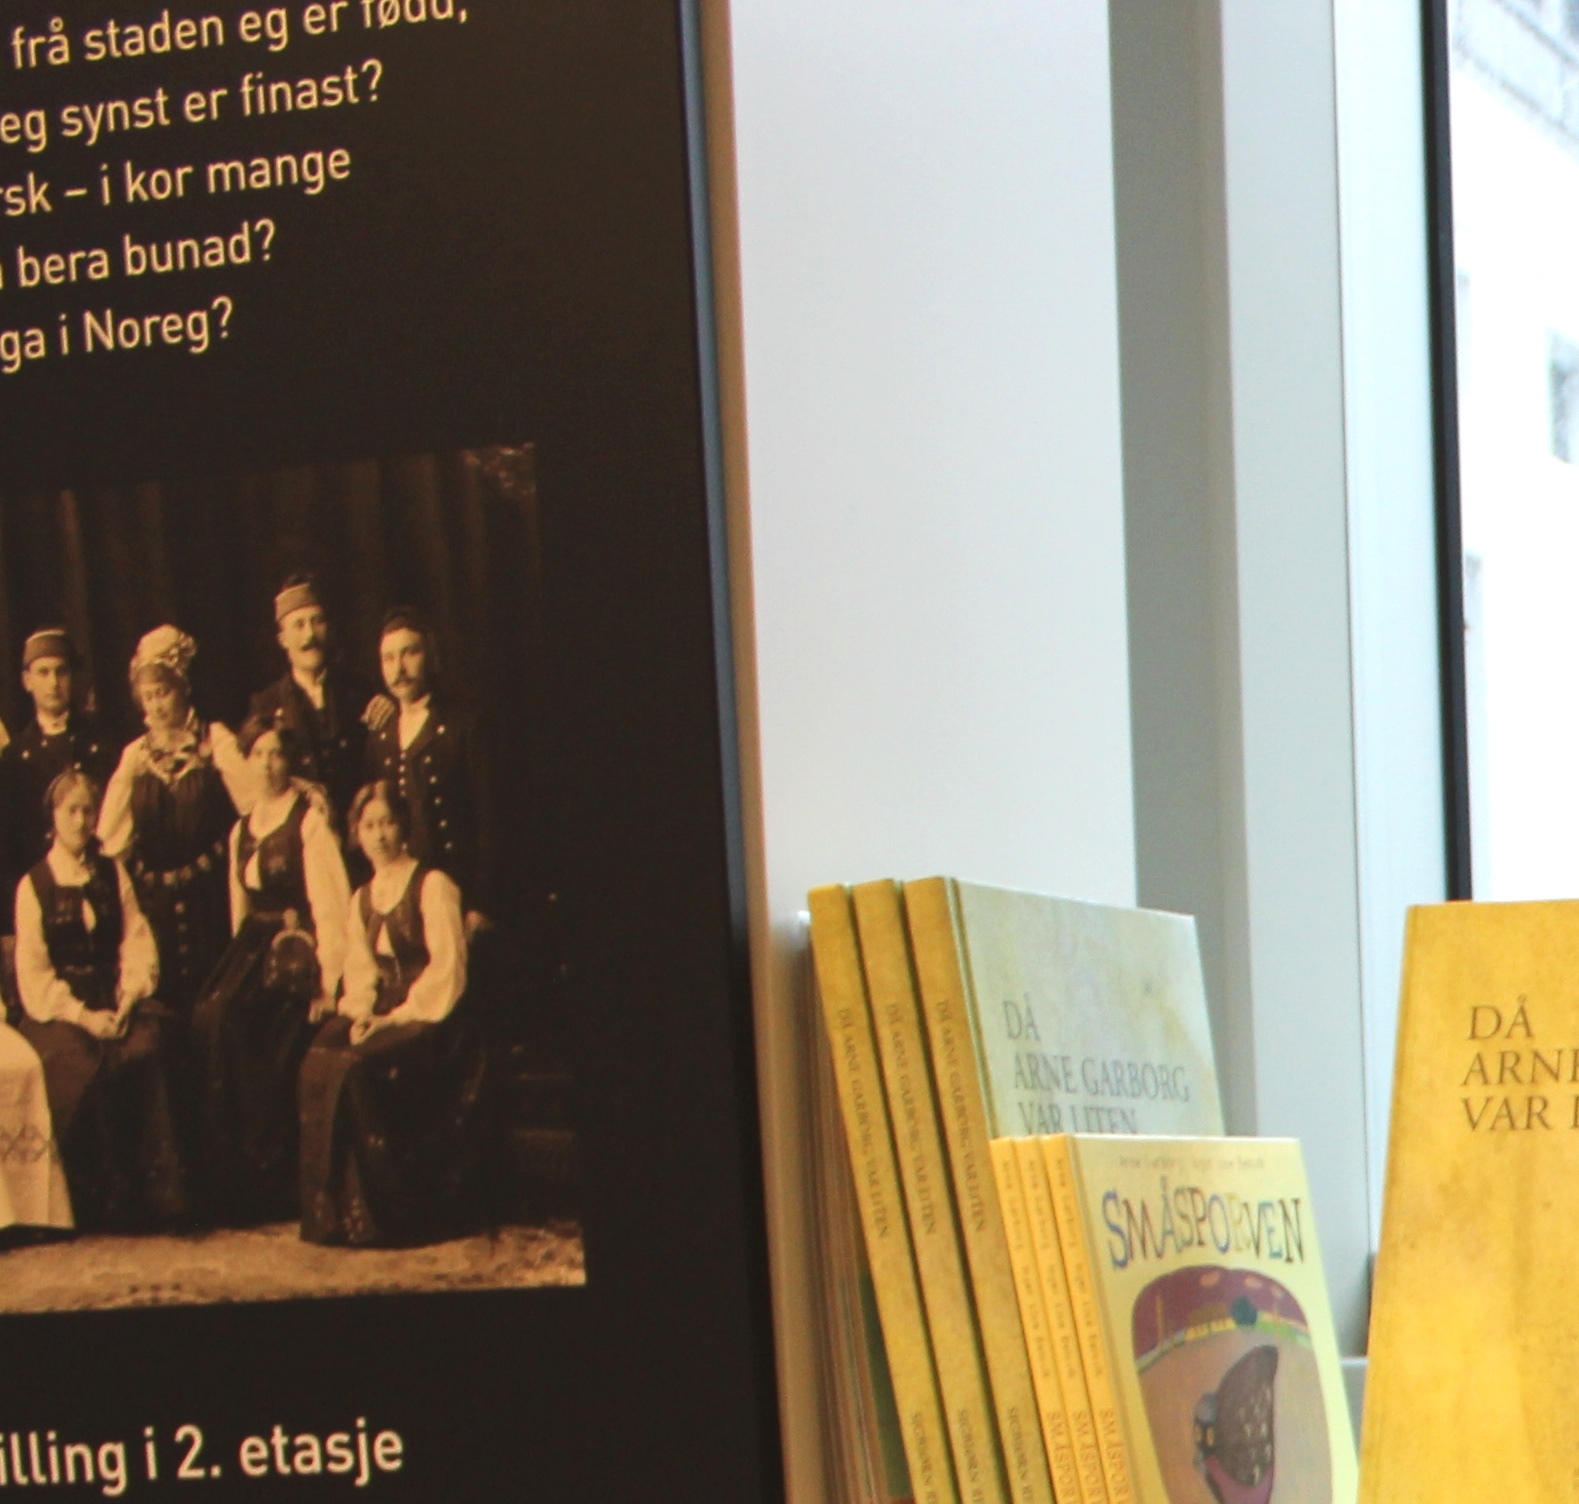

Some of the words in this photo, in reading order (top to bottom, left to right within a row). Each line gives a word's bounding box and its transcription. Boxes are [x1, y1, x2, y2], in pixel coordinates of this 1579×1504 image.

[10, 16, 70, 70] frå
[84, 9, 225, 62] staden
[238, 6, 289, 52] eg
[302, 0, 348, 35] er
[0, 107, 47, 153] eg
[60, 87, 171, 146] synst
[183, 89, 228, 122] er
[240, 58, 383, 118] finast?
[100, 163, 111, 206] i
[123, 160, 194, 203] kor
[206, 147, 351, 196] mange
[16, 245, 110, 289] bera
[123, 218, 276, 277] bunad?
[58, 313, 69, 356] i
[83, 295, 234, 354] Noreg?
[1467, 994, 1534, 1041] DÅ
[1014, 1053, 1077, 1094] ARNE
[1081, 1057, 1190, 1102] GARBORG
[1459, 1094, 1553, 1132] VAR
[1101, 1174, 1305, 1270] SMÅSPORVEN
[143, 1426, 158, 1481] i
[174, 1424, 222, 1479] 2.
[239, 1417, 403, 1487] etasje
